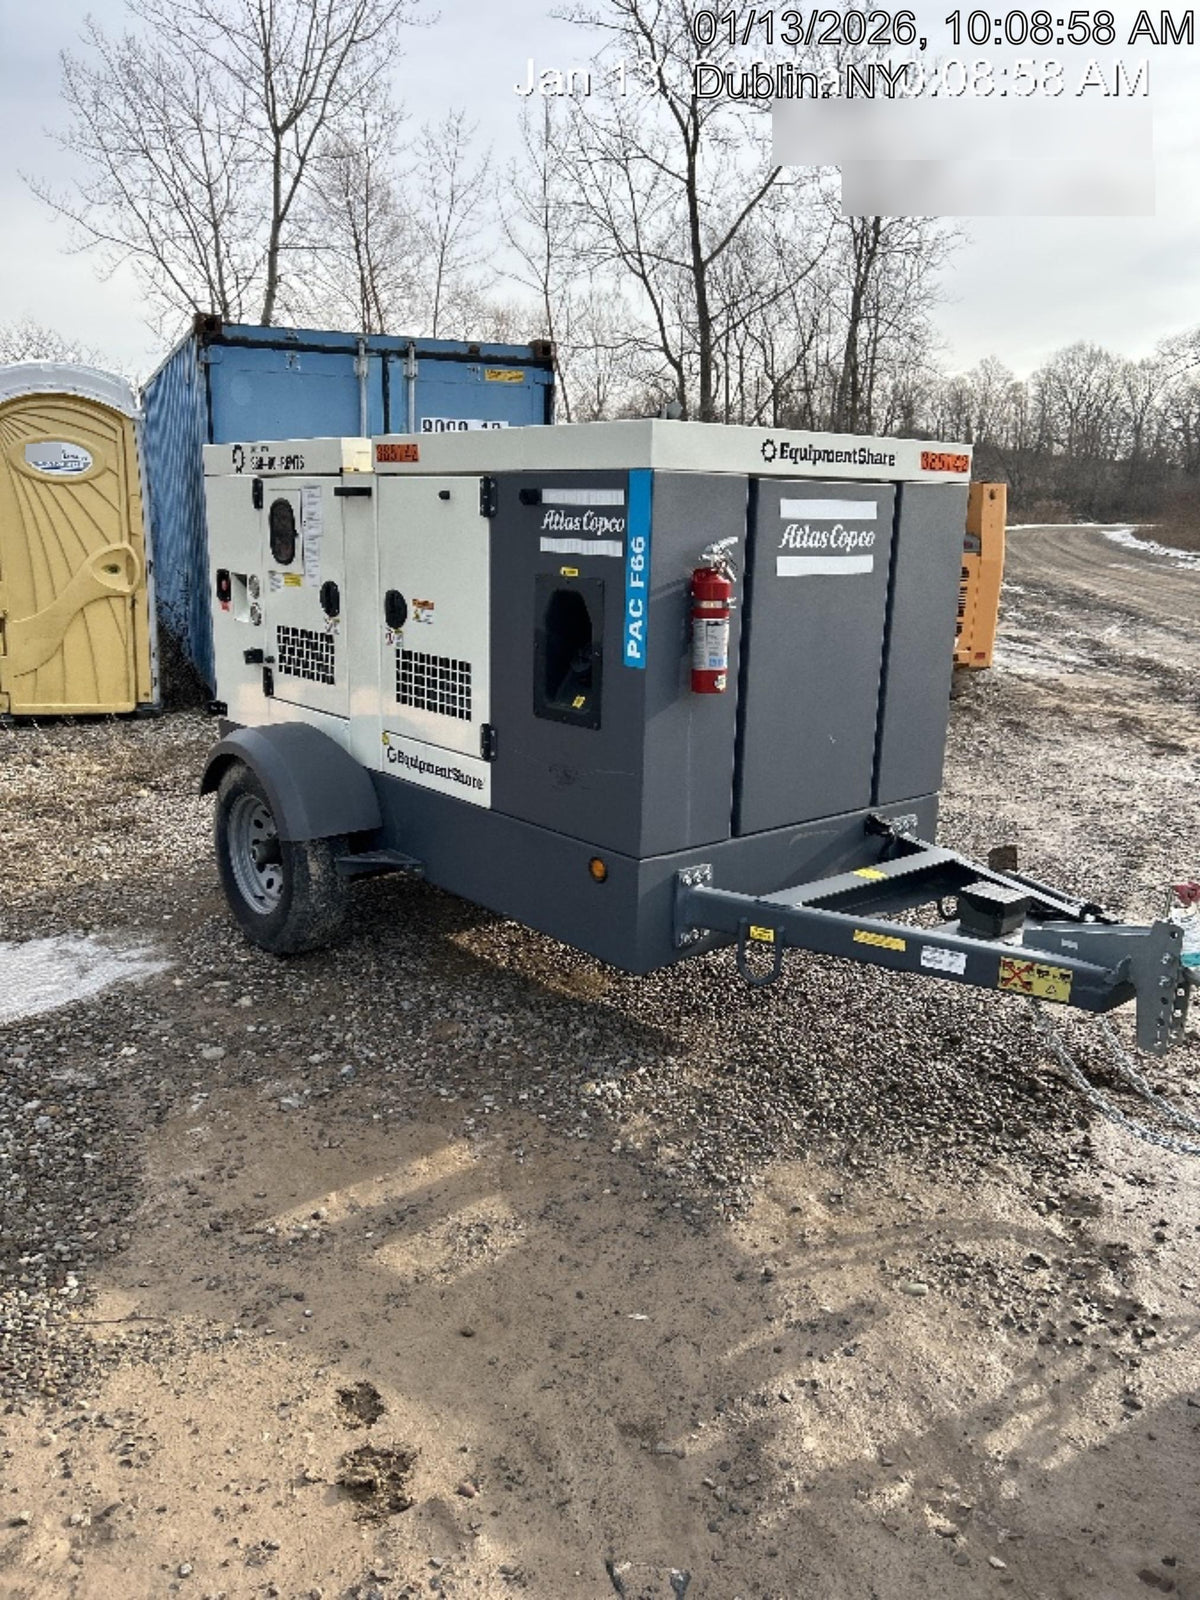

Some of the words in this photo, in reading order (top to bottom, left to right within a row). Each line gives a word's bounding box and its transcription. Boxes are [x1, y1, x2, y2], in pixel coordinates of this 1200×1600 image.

[780, 442, 896, 467] EquipmentShare
[540, 509, 582, 531] Atlas
[582, 509, 625, 536] Copco
[777, 523, 829, 549] Atlas
[829, 523, 876, 553] Copco
[626, 598, 643, 659] PAC
[397, 749, 484, 790] EquipmentShare
